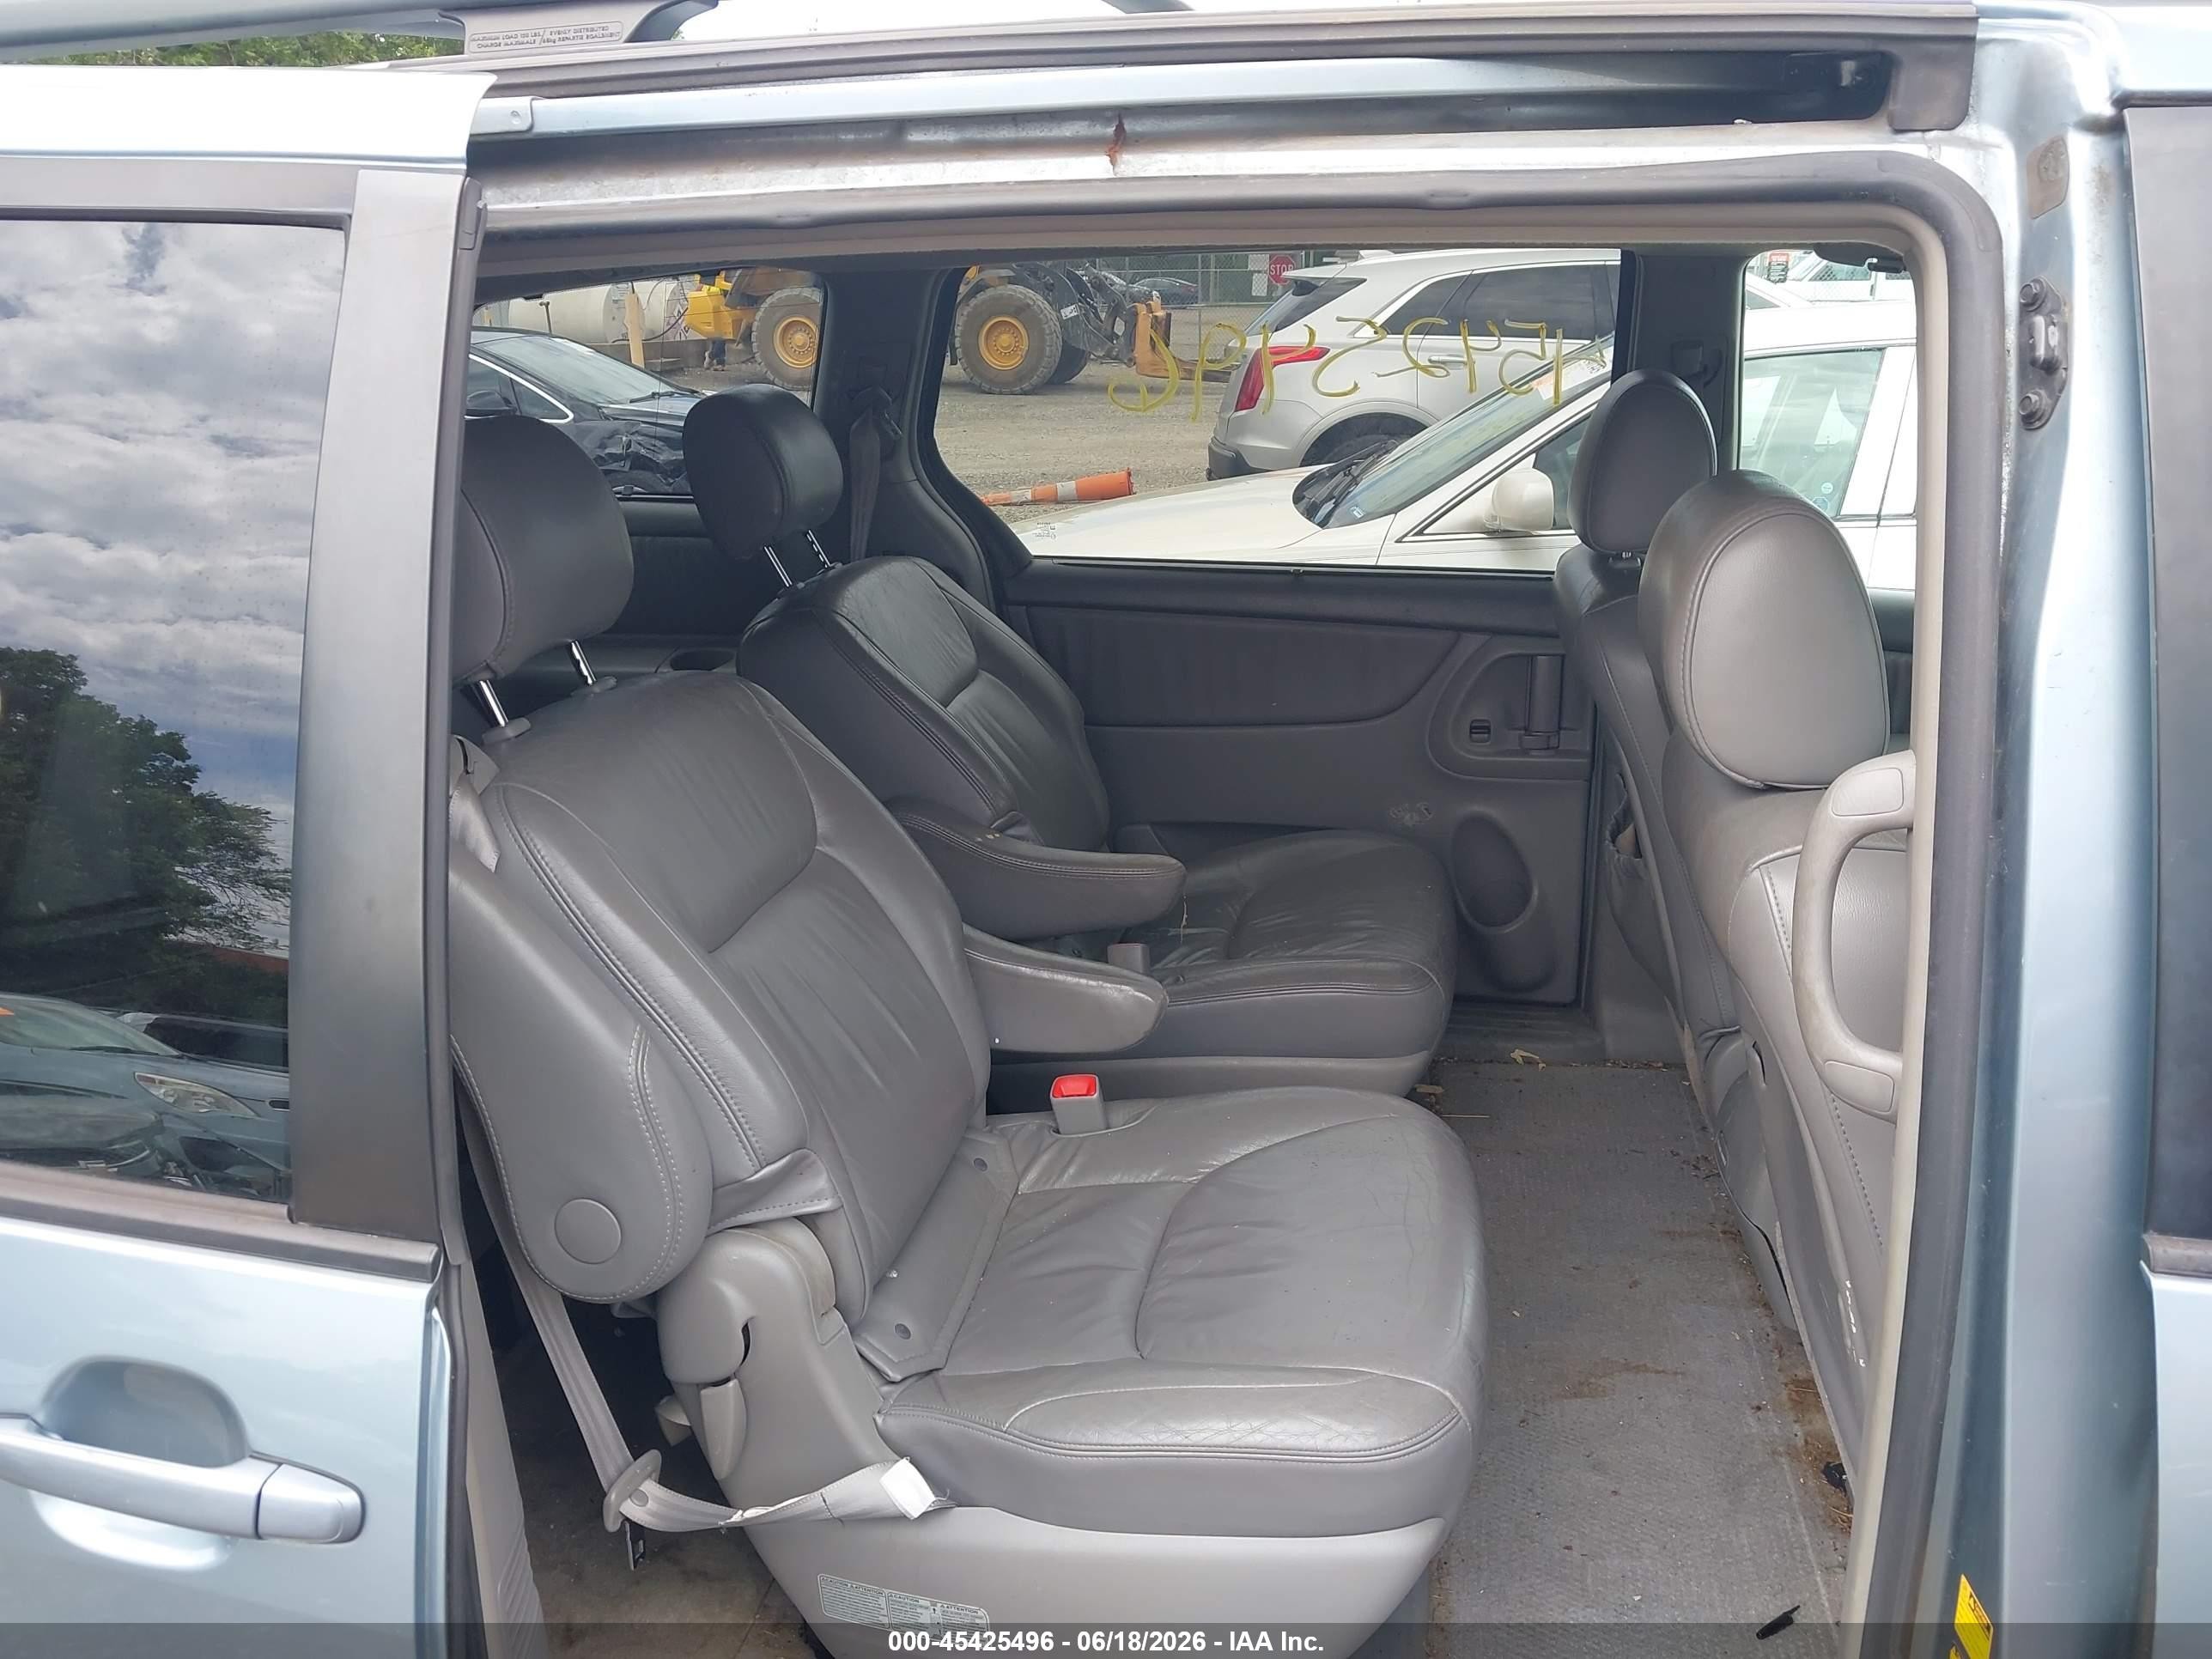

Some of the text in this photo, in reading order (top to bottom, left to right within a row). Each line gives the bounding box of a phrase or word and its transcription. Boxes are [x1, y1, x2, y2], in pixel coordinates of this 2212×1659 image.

[571, 25, 609, 33] DISTRIBUTED
[1270, 264, 1294, 276] STOP
[825, 1577, 884, 1595] CAUTION ATTENTION
[894, 1594, 920, 1603] CAUTION
[946, 1604, 979, 1614] ATTENTION
